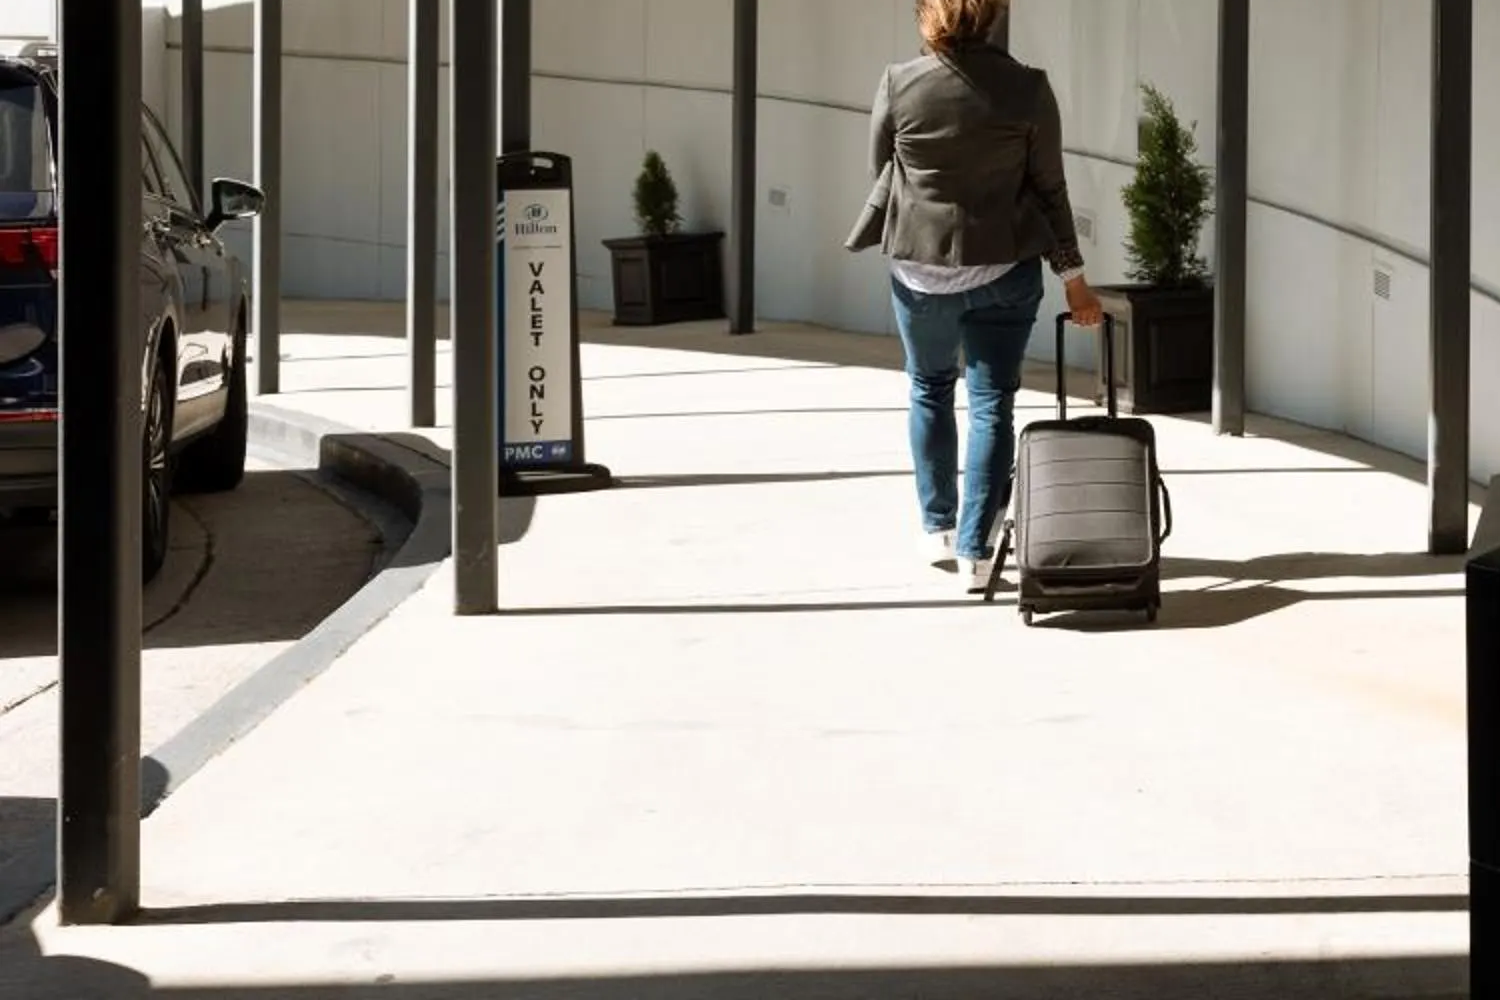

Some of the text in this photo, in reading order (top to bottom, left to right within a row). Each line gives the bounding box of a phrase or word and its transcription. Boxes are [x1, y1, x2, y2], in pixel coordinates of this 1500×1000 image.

[528, 262, 545, 434] VALET ONLY
[504, 445, 543, 460] PMC
